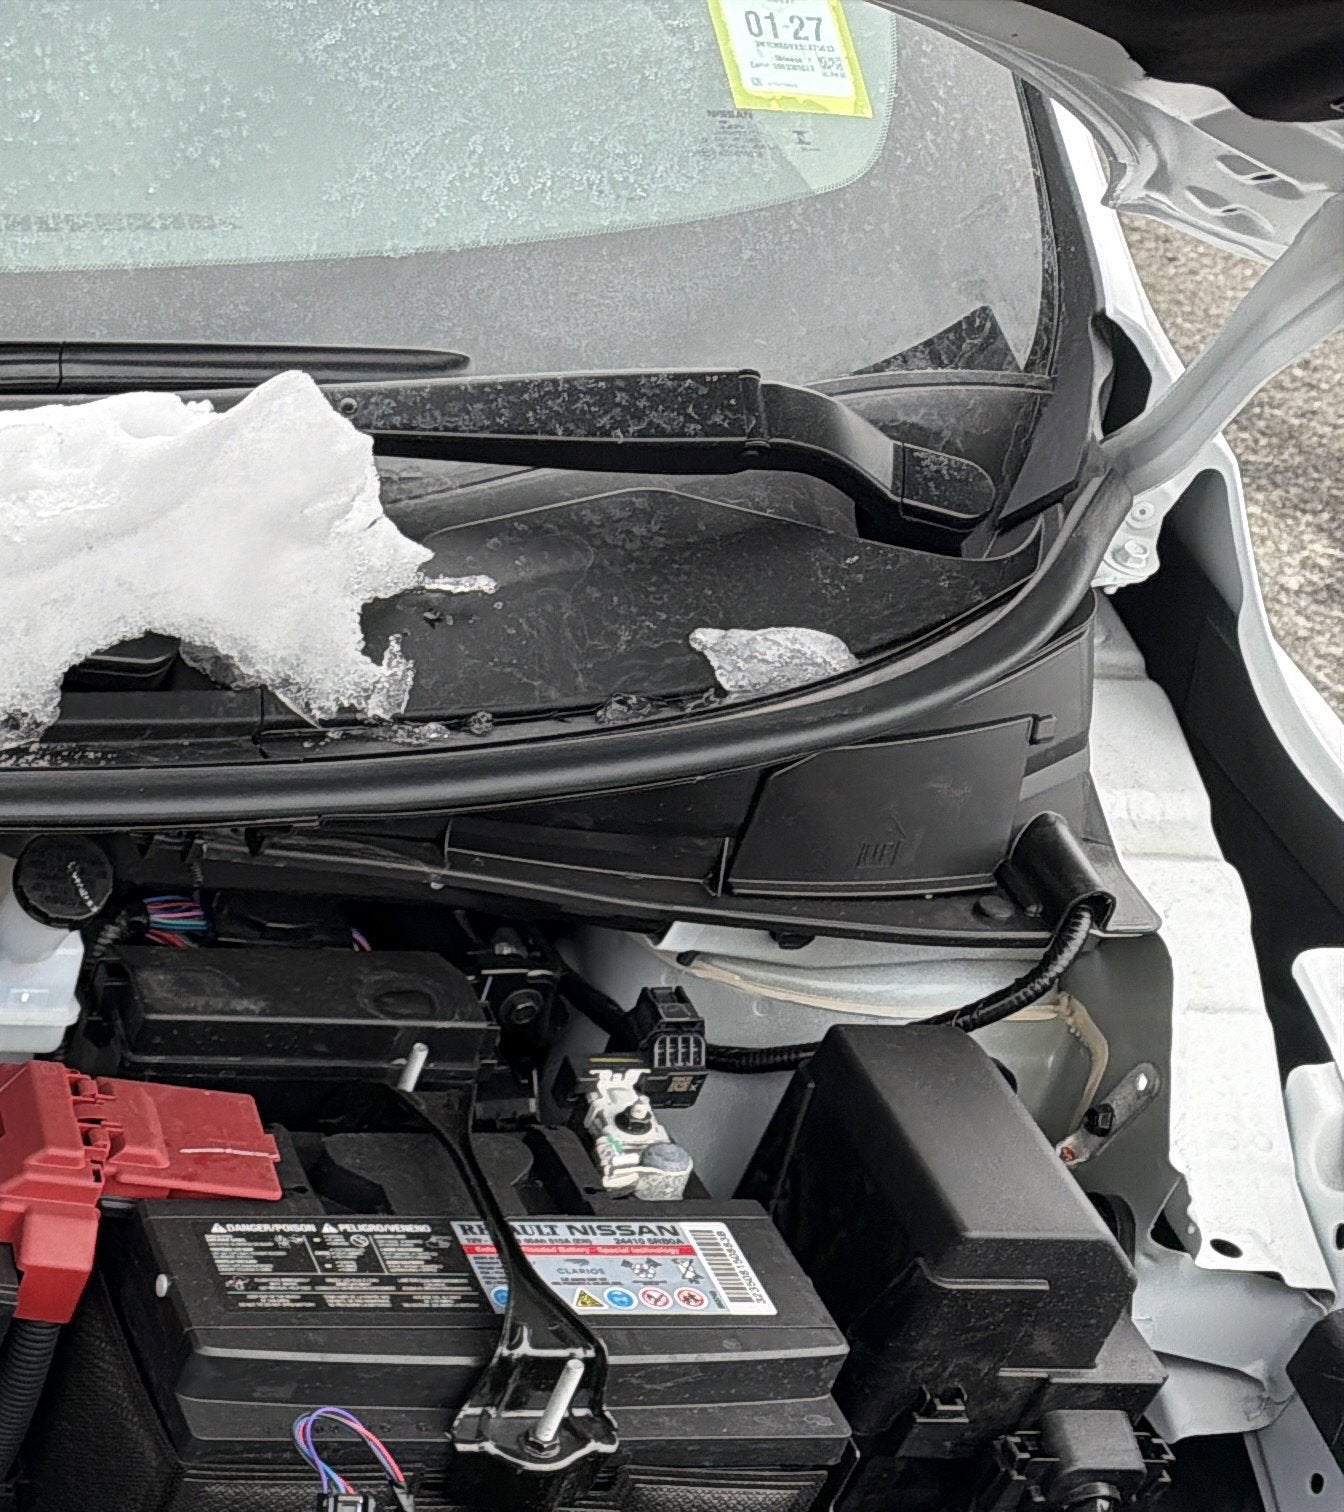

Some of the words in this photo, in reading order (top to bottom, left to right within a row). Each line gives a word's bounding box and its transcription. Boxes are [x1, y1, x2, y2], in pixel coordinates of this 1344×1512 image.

[745, 10, 823, 42] 01-27
[226, 1224, 317, 1232] DANGER/POISON
[338, 1224, 432, 1232] PELIGRO/VENENO
[565, 1224, 680, 1236] NISSAN
